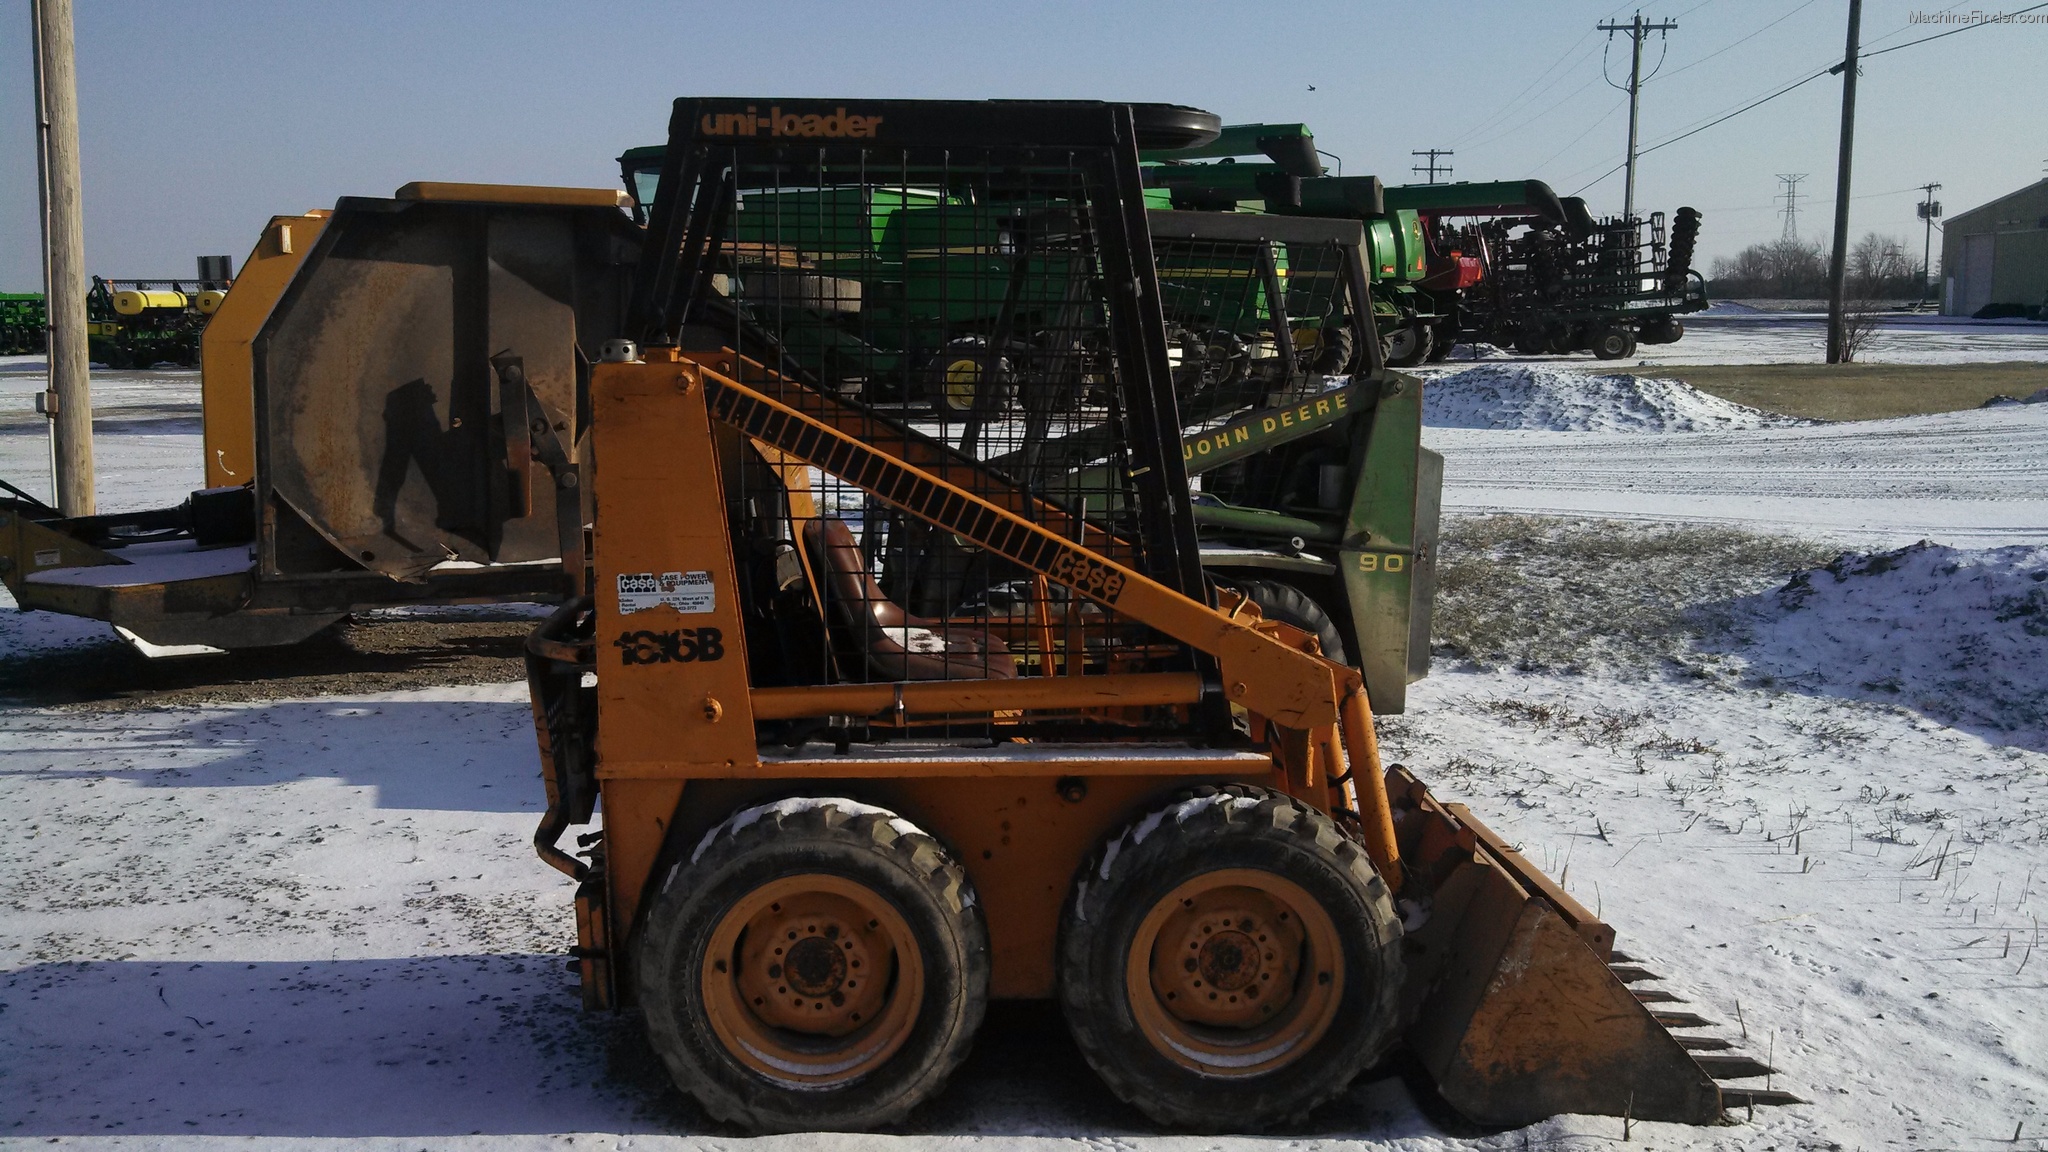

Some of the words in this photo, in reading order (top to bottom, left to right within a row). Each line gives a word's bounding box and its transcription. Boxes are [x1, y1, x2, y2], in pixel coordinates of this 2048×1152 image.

[701, 106, 883, 138] uni-loader
[1184, 426, 1248, 460] JOHN
[1262, 393, 1348, 434] DEERE
[1359, 554, 1404, 572] 90
[621, 578, 656, 590] case
